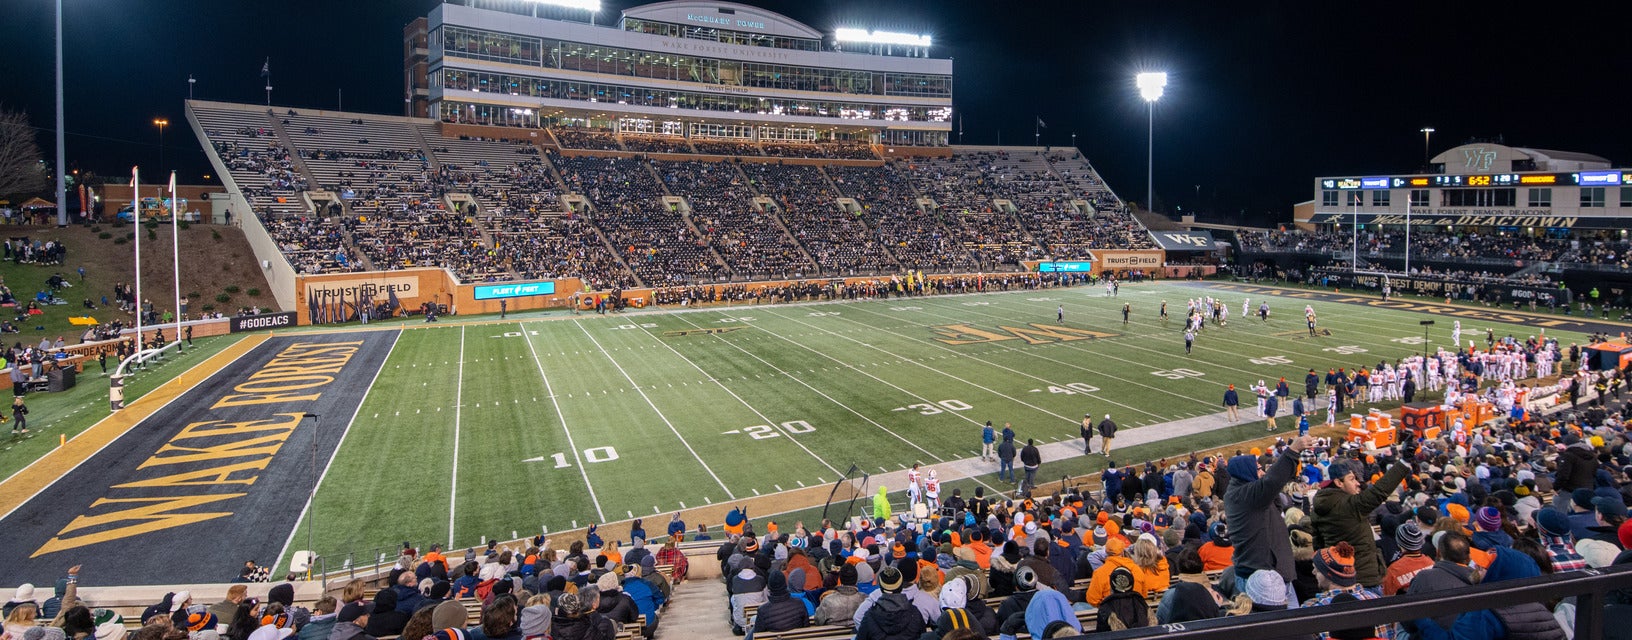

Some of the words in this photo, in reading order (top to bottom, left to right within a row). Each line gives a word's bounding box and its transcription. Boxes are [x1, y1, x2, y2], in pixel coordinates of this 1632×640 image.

[662, 40, 688, 50] WAKE
[693, 43, 728, 54] FOREST
[732, 48, 789, 60] UNIVERSITY
[1323, 180, 1334, 189] 40
[1468, 175, 1491, 186] 6:52
[1571, 174, 1580, 183] 7
[1369, 214, 1434, 225] Welcome
[1455, 215, 1579, 228] DEACTOWN
[1163, 233, 1209, 247] WF
[315, 285, 360, 298] TRUIST
[379, 283, 412, 294] FIELD
[1413, 280, 1442, 291] DEMON
[1511, 288, 1550, 300] #GODACS
[239, 314, 290, 330] #GODEACS
[210, 340, 364, 410] FOREST
[1150, 368, 1206, 380] 50
[1047, 382, 1101, 395] 40
[908, 399, 974, 416] 30
[743, 419, 818, 440] 20
[550, 446, 620, 469] 10
[29, 412, 308, 559] WAKE
[1162, 622, 1186, 633] 20
